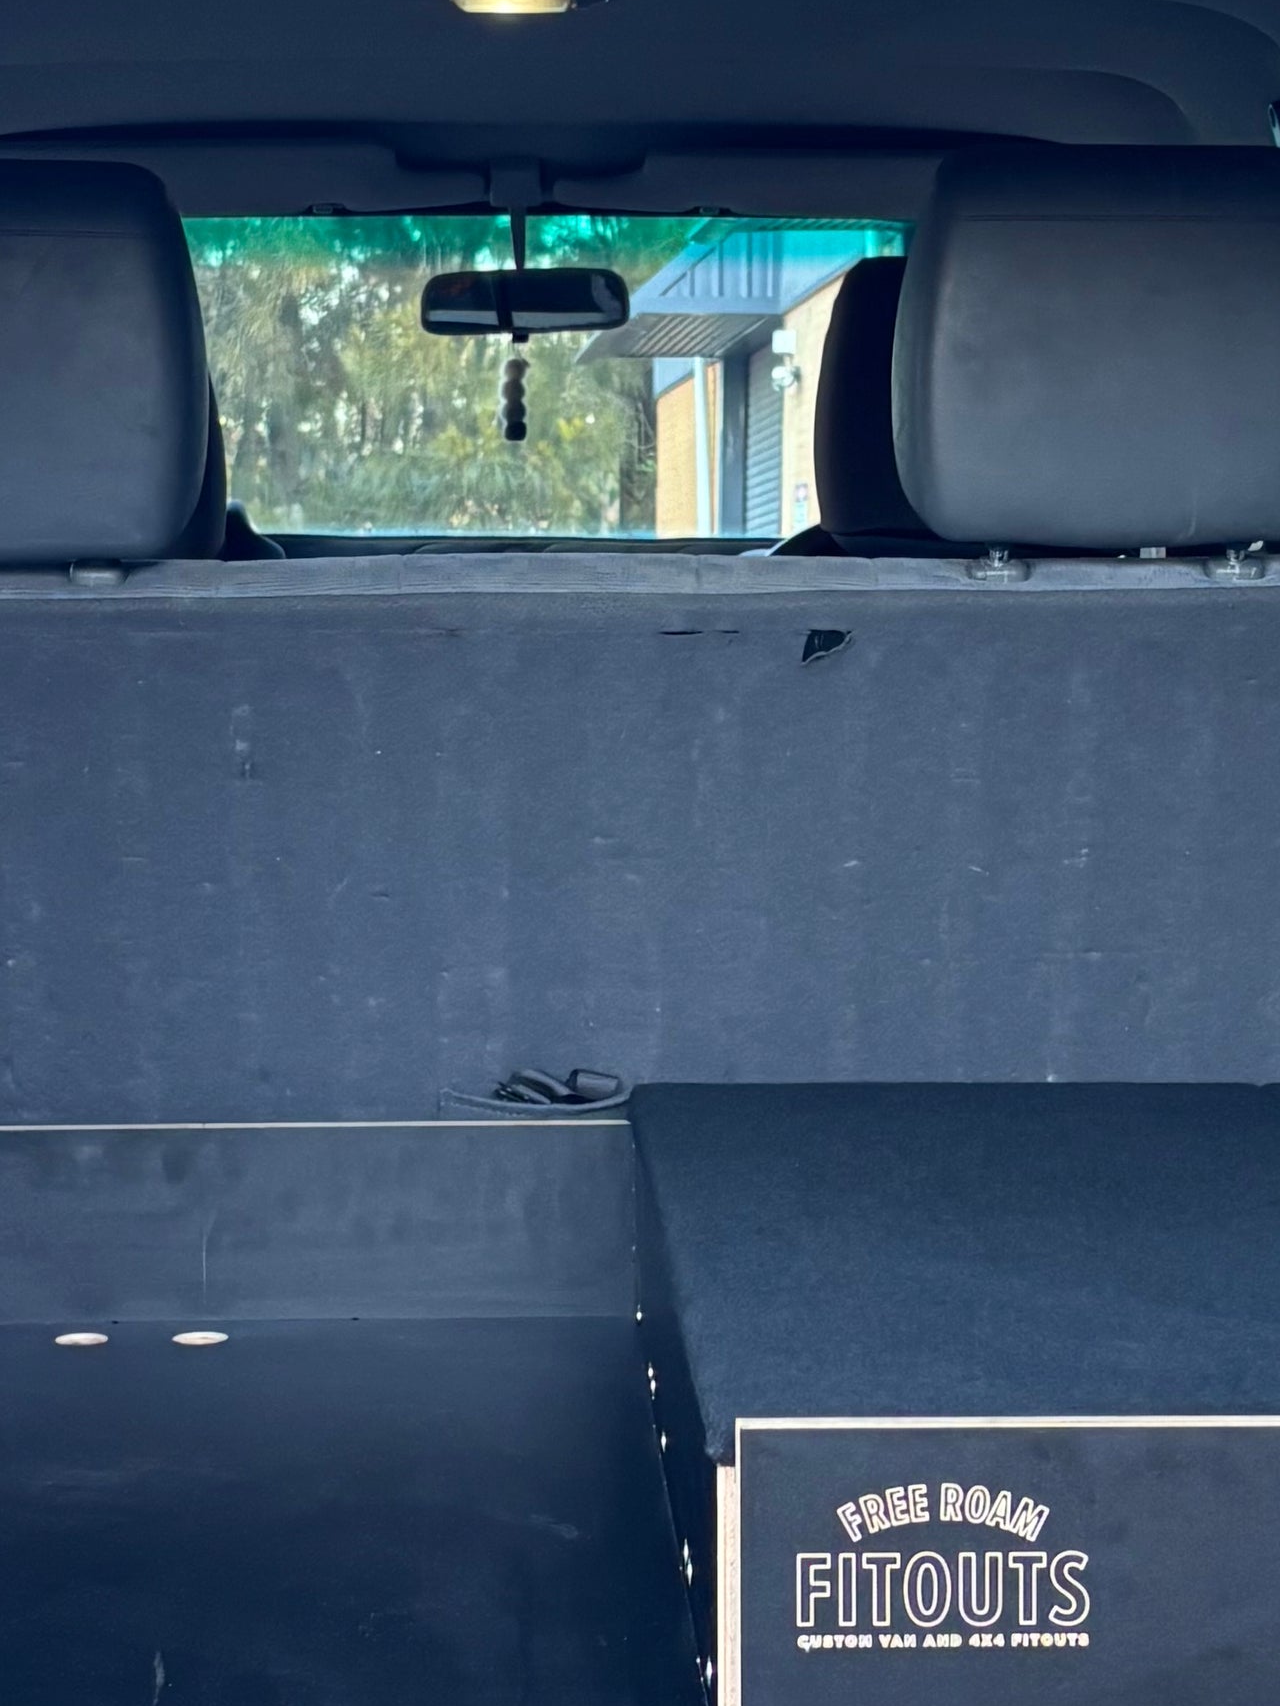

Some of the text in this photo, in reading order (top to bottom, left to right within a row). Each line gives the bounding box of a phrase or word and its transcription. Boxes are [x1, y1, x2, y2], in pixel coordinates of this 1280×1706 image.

[836, 1482, 1050, 1543] FREE ROAM
[796, 1549, 1091, 1627] FITOUTS
[878, 1634, 917, 1649] VAN
[922, 1633, 963, 1648] AND
[1011, 1632, 1090, 1648] FITOUTS
